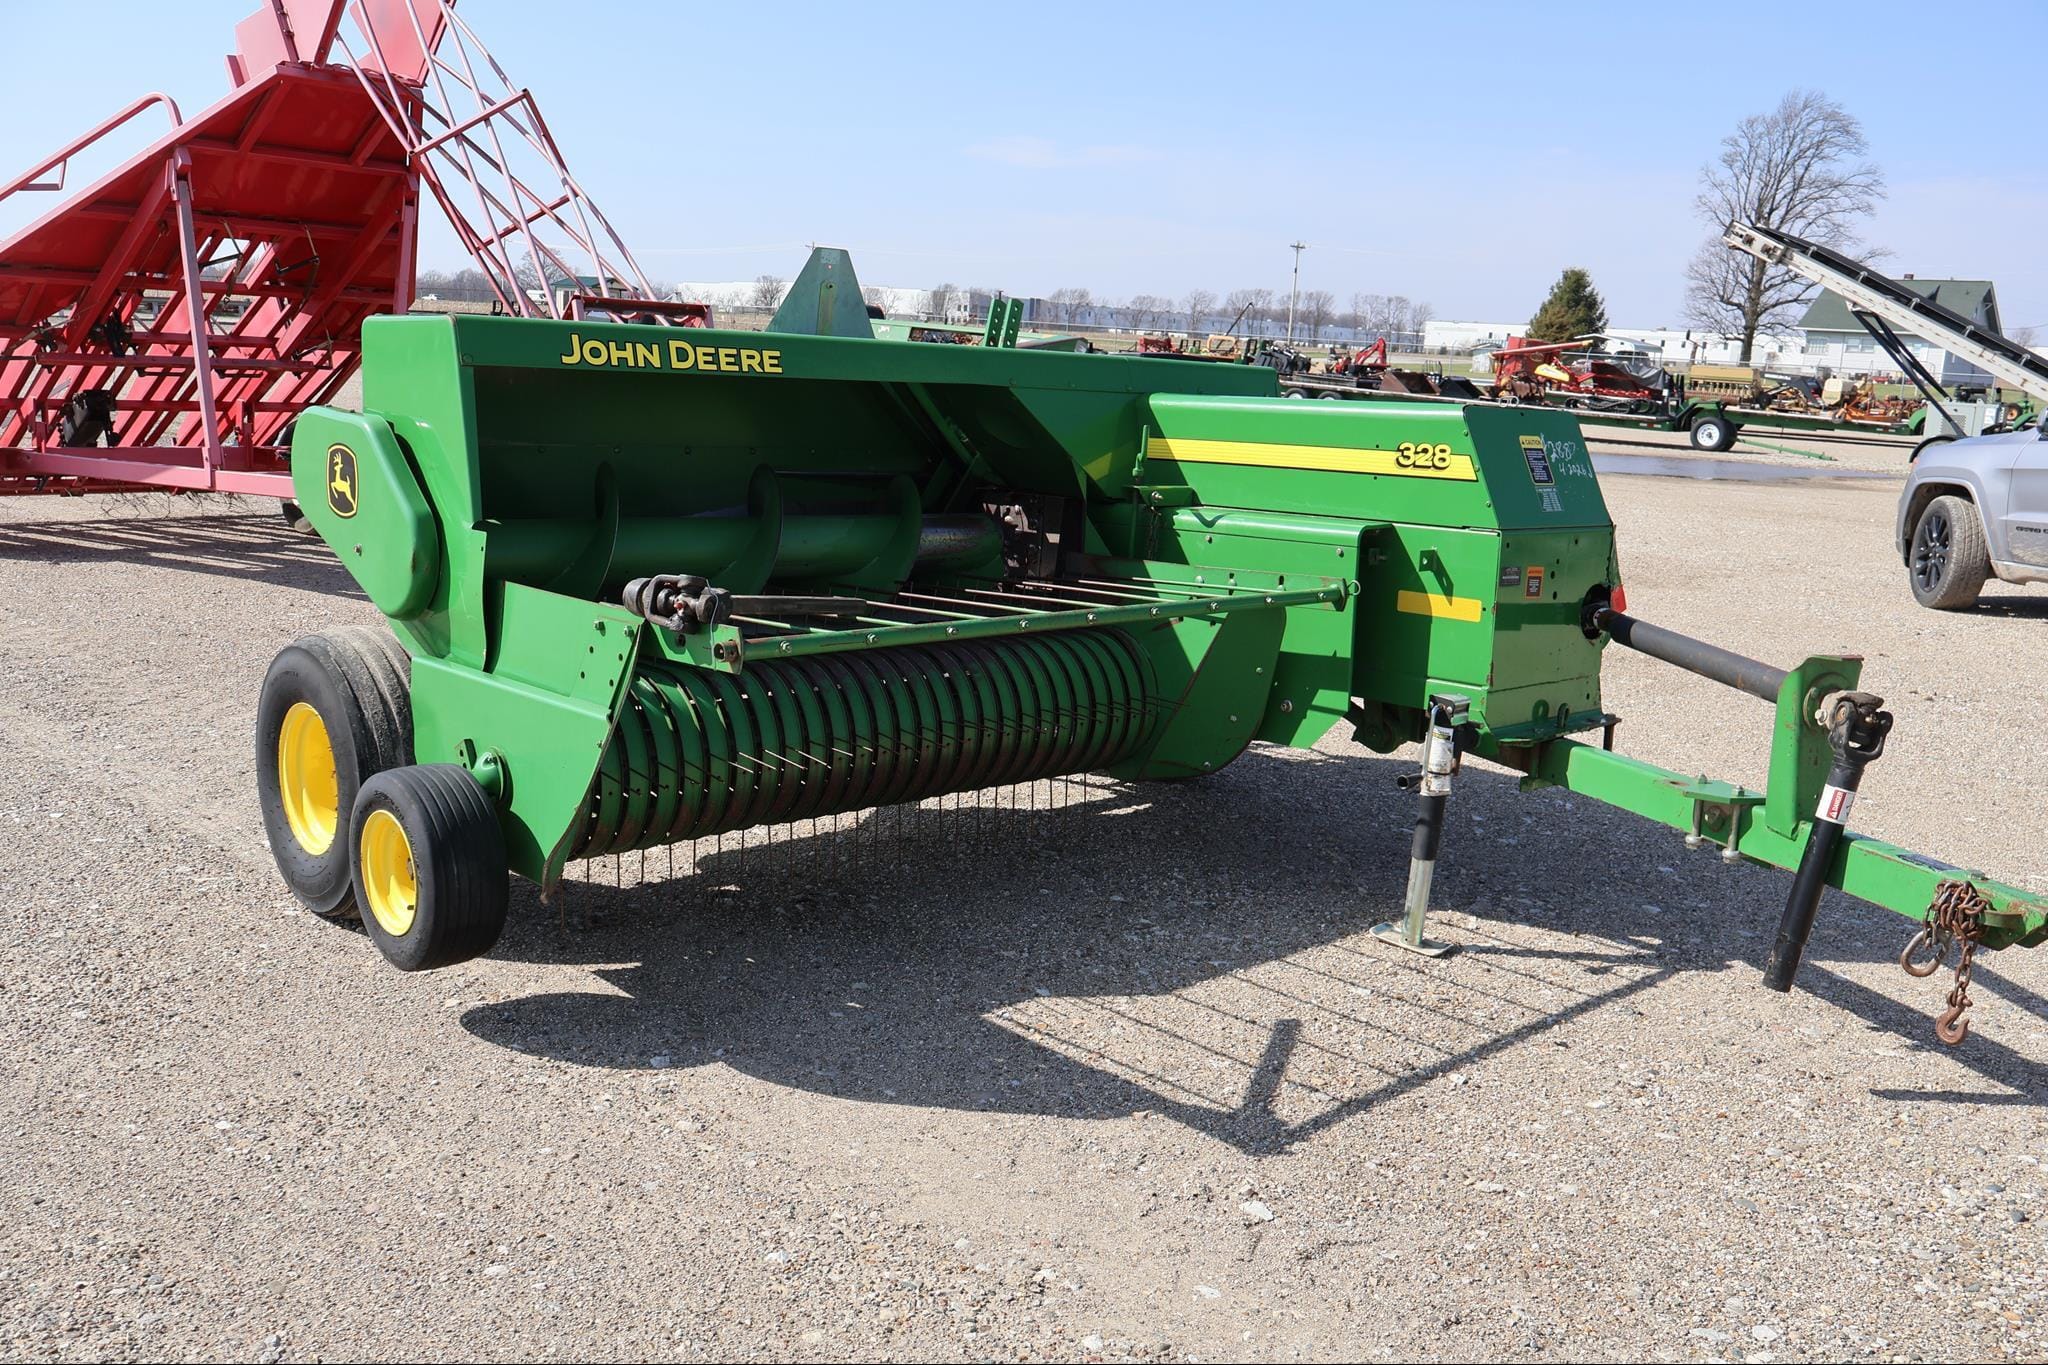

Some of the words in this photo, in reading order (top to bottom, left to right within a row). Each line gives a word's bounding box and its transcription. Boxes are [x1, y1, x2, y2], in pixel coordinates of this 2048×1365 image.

[561, 333, 661, 369] JOHN
[668, 339, 783, 374] DEERE
[1396, 441, 1452, 470] 328
